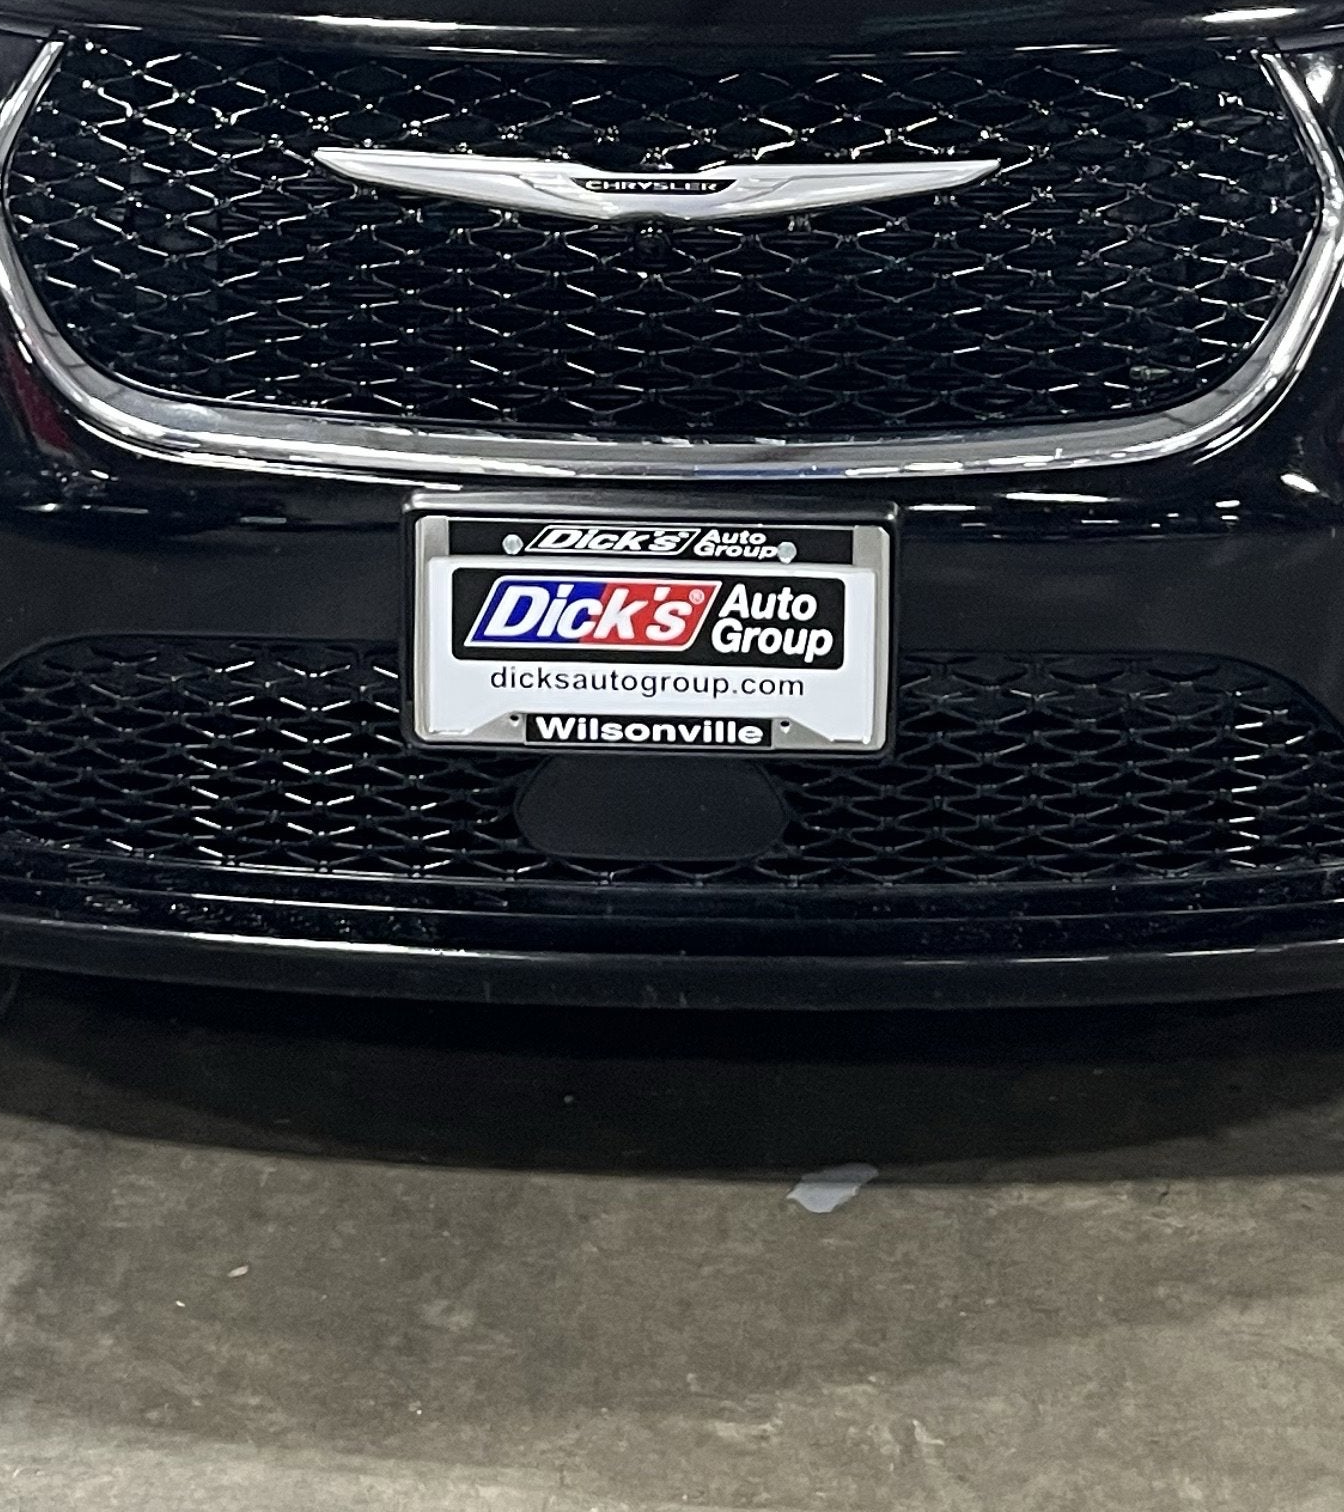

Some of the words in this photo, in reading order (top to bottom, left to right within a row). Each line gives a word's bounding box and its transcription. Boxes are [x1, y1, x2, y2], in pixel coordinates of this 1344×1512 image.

[585, 179, 716, 191] CHRYSLER
[538, 528, 681, 552] Dick's
[693, 542, 778, 560] Group
[700, 529, 767, 545] Auto
[483, 581, 691, 641] Dick's
[718, 583, 817, 621] Auto
[712, 619, 833, 663] Group
[490, 666, 805, 698] dicksautogroup.com
[535, 715, 764, 745] Wilsonville
